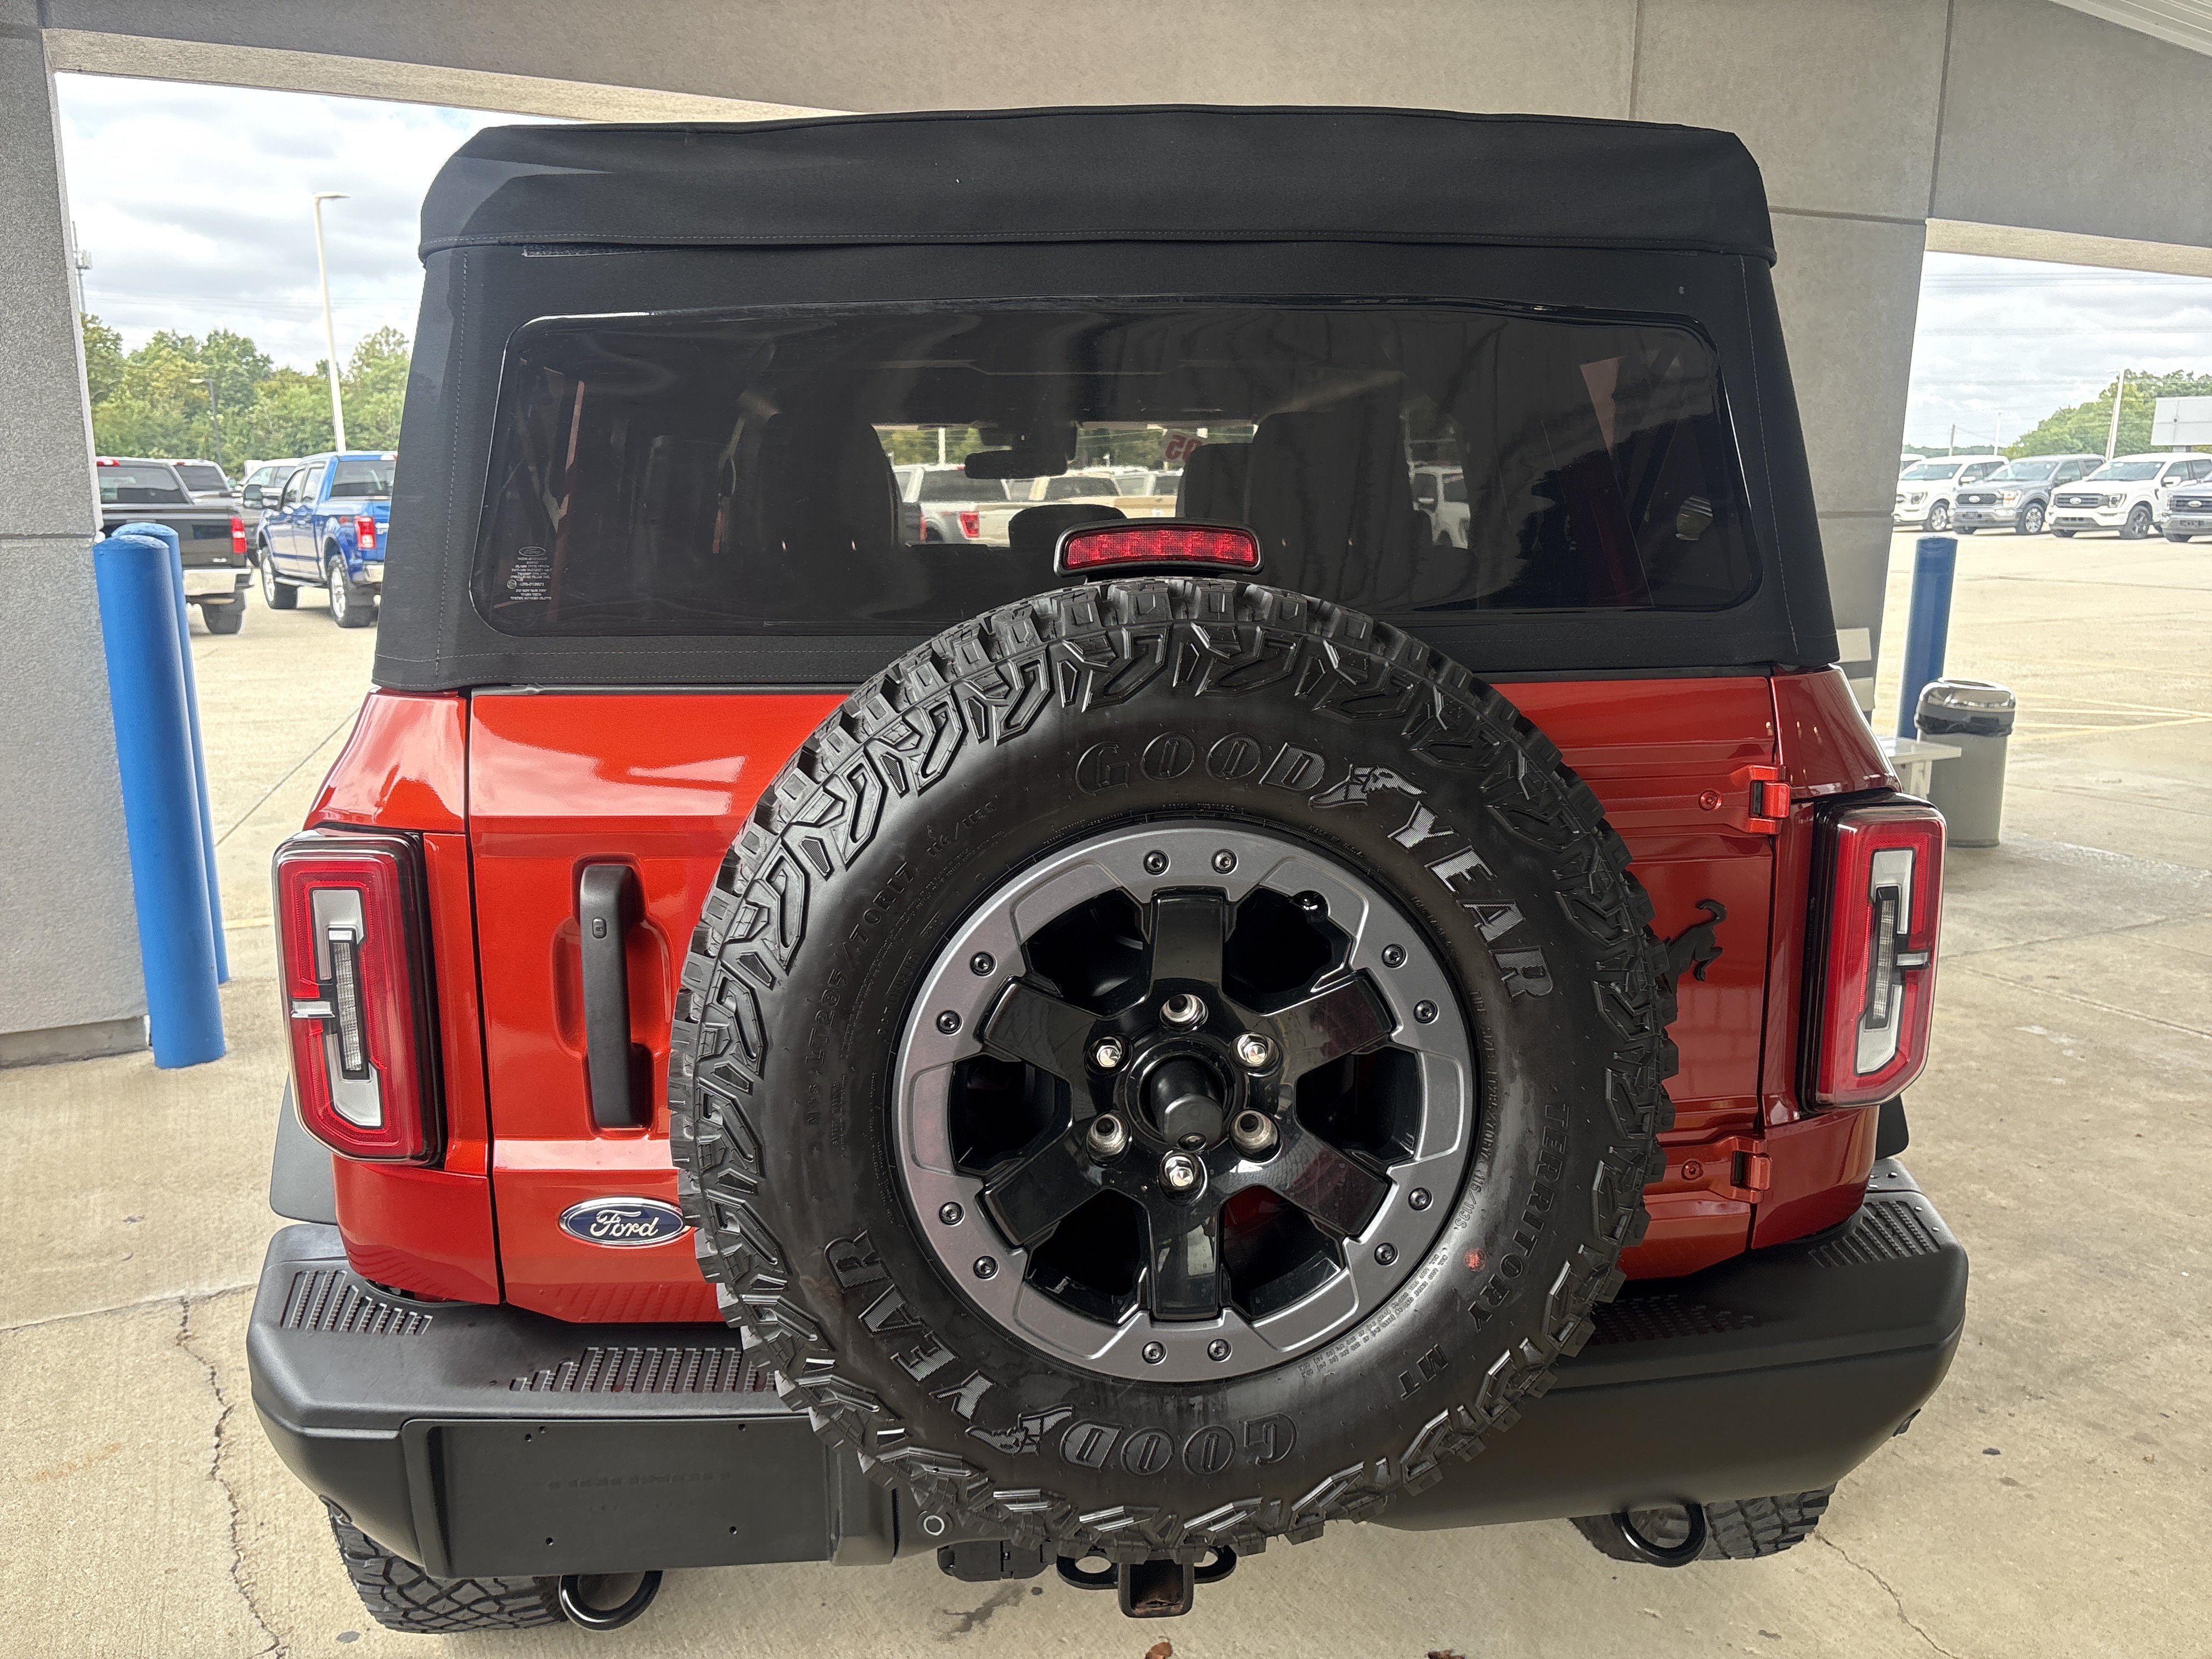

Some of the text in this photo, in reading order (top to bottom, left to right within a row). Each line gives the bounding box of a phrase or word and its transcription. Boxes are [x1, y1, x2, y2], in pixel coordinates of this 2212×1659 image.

[590, 1209, 659, 1237] Ford
[1455, 1174, 1484, 1229] 116/113S
[1398, 1103, 1570, 1400] TERRITORY MT
